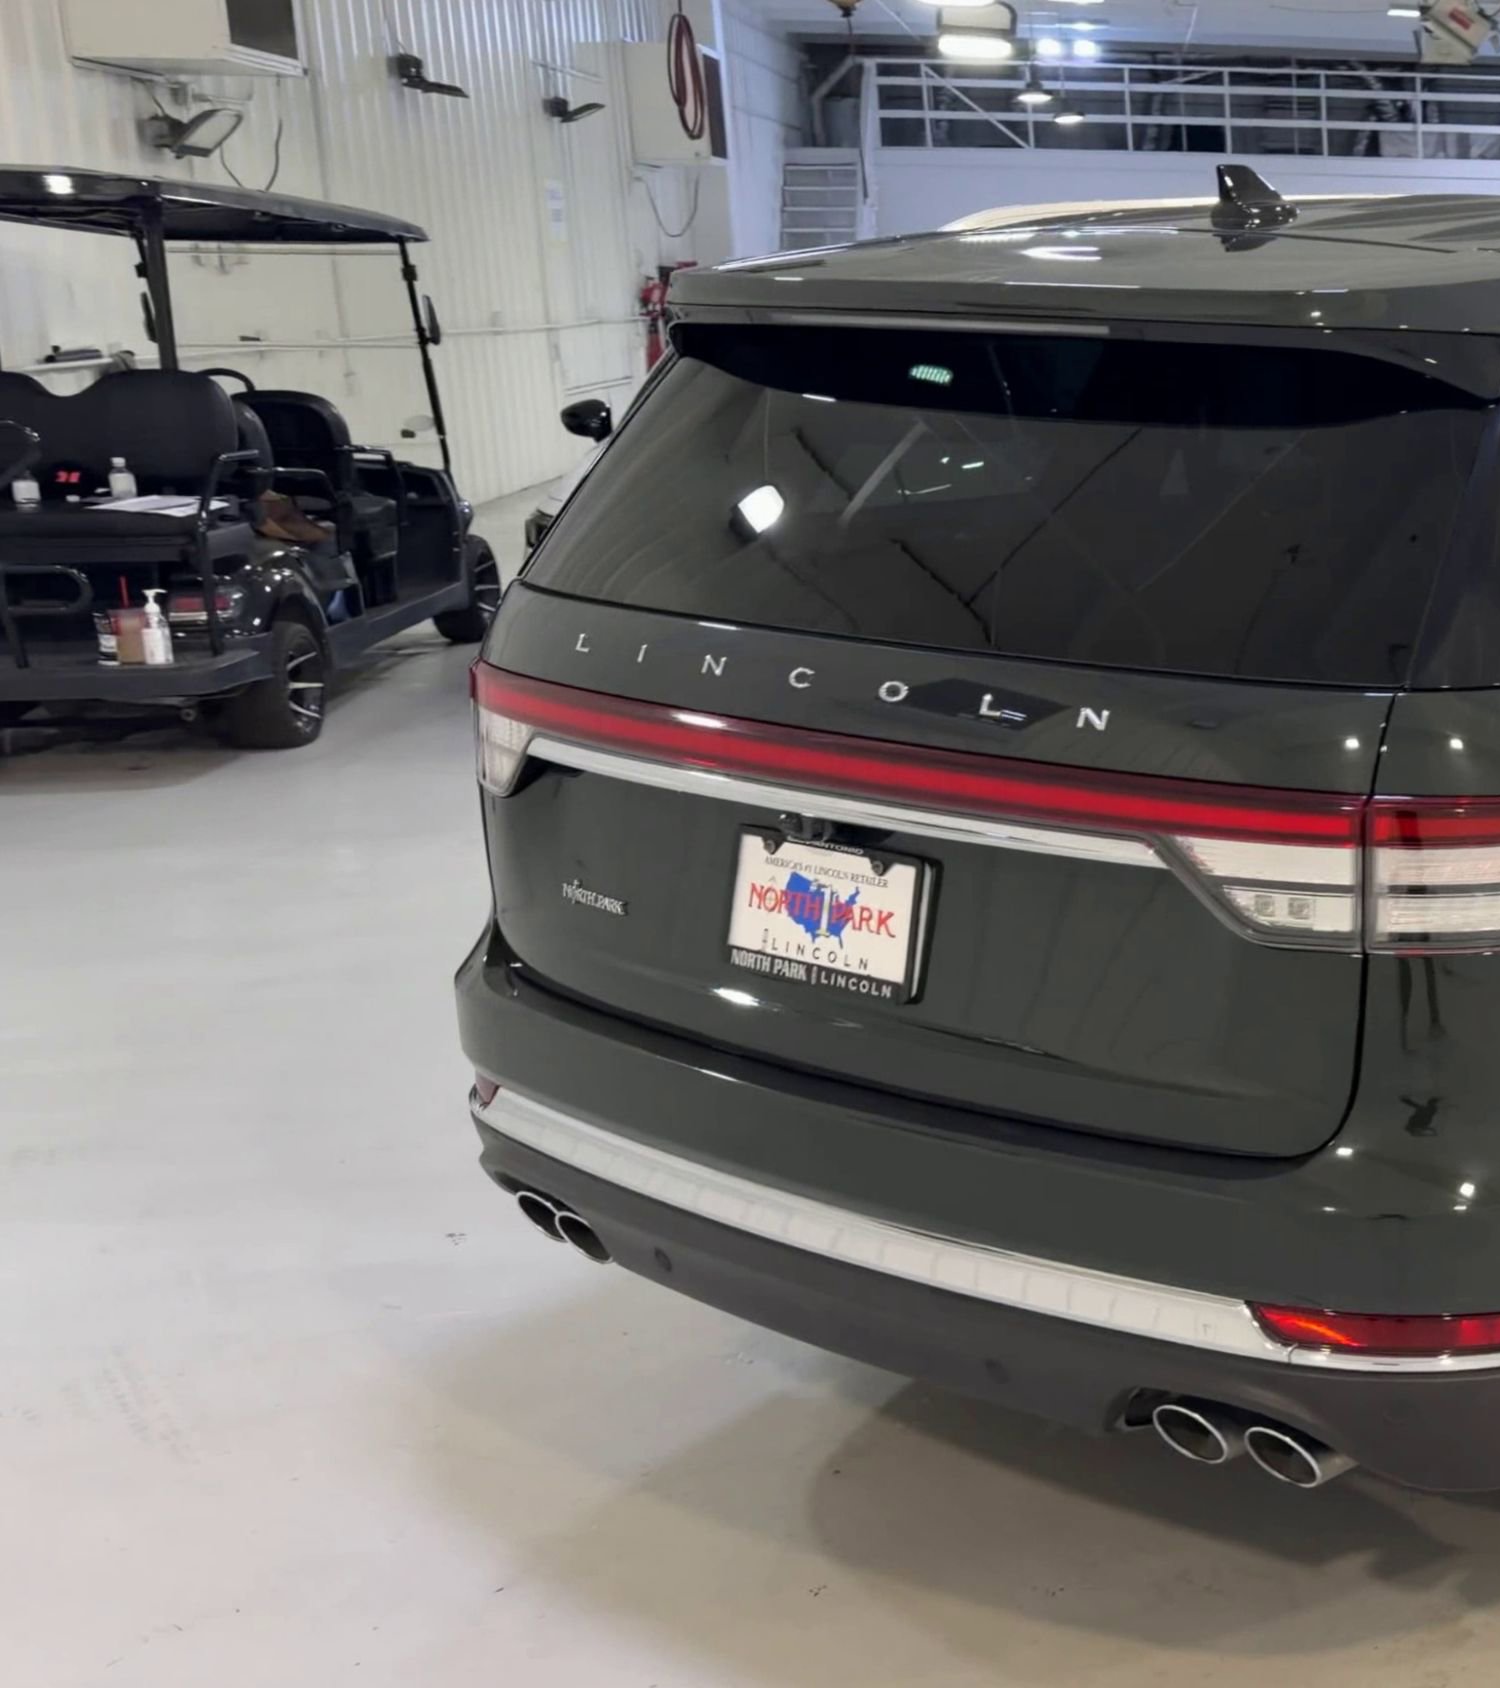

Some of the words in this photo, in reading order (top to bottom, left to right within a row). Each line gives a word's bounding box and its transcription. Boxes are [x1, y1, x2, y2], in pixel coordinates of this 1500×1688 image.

[575, 633, 1111, 732] LINCOLN
[748, 882, 821, 921] NORTH
[830, 893, 897, 939] PARK
[730, 948, 772, 973] NORTH
[773, 957, 808, 982] PARK
[820, 970, 893, 999] LINCOLN
[771, 937, 870, 972] LINCOLN
